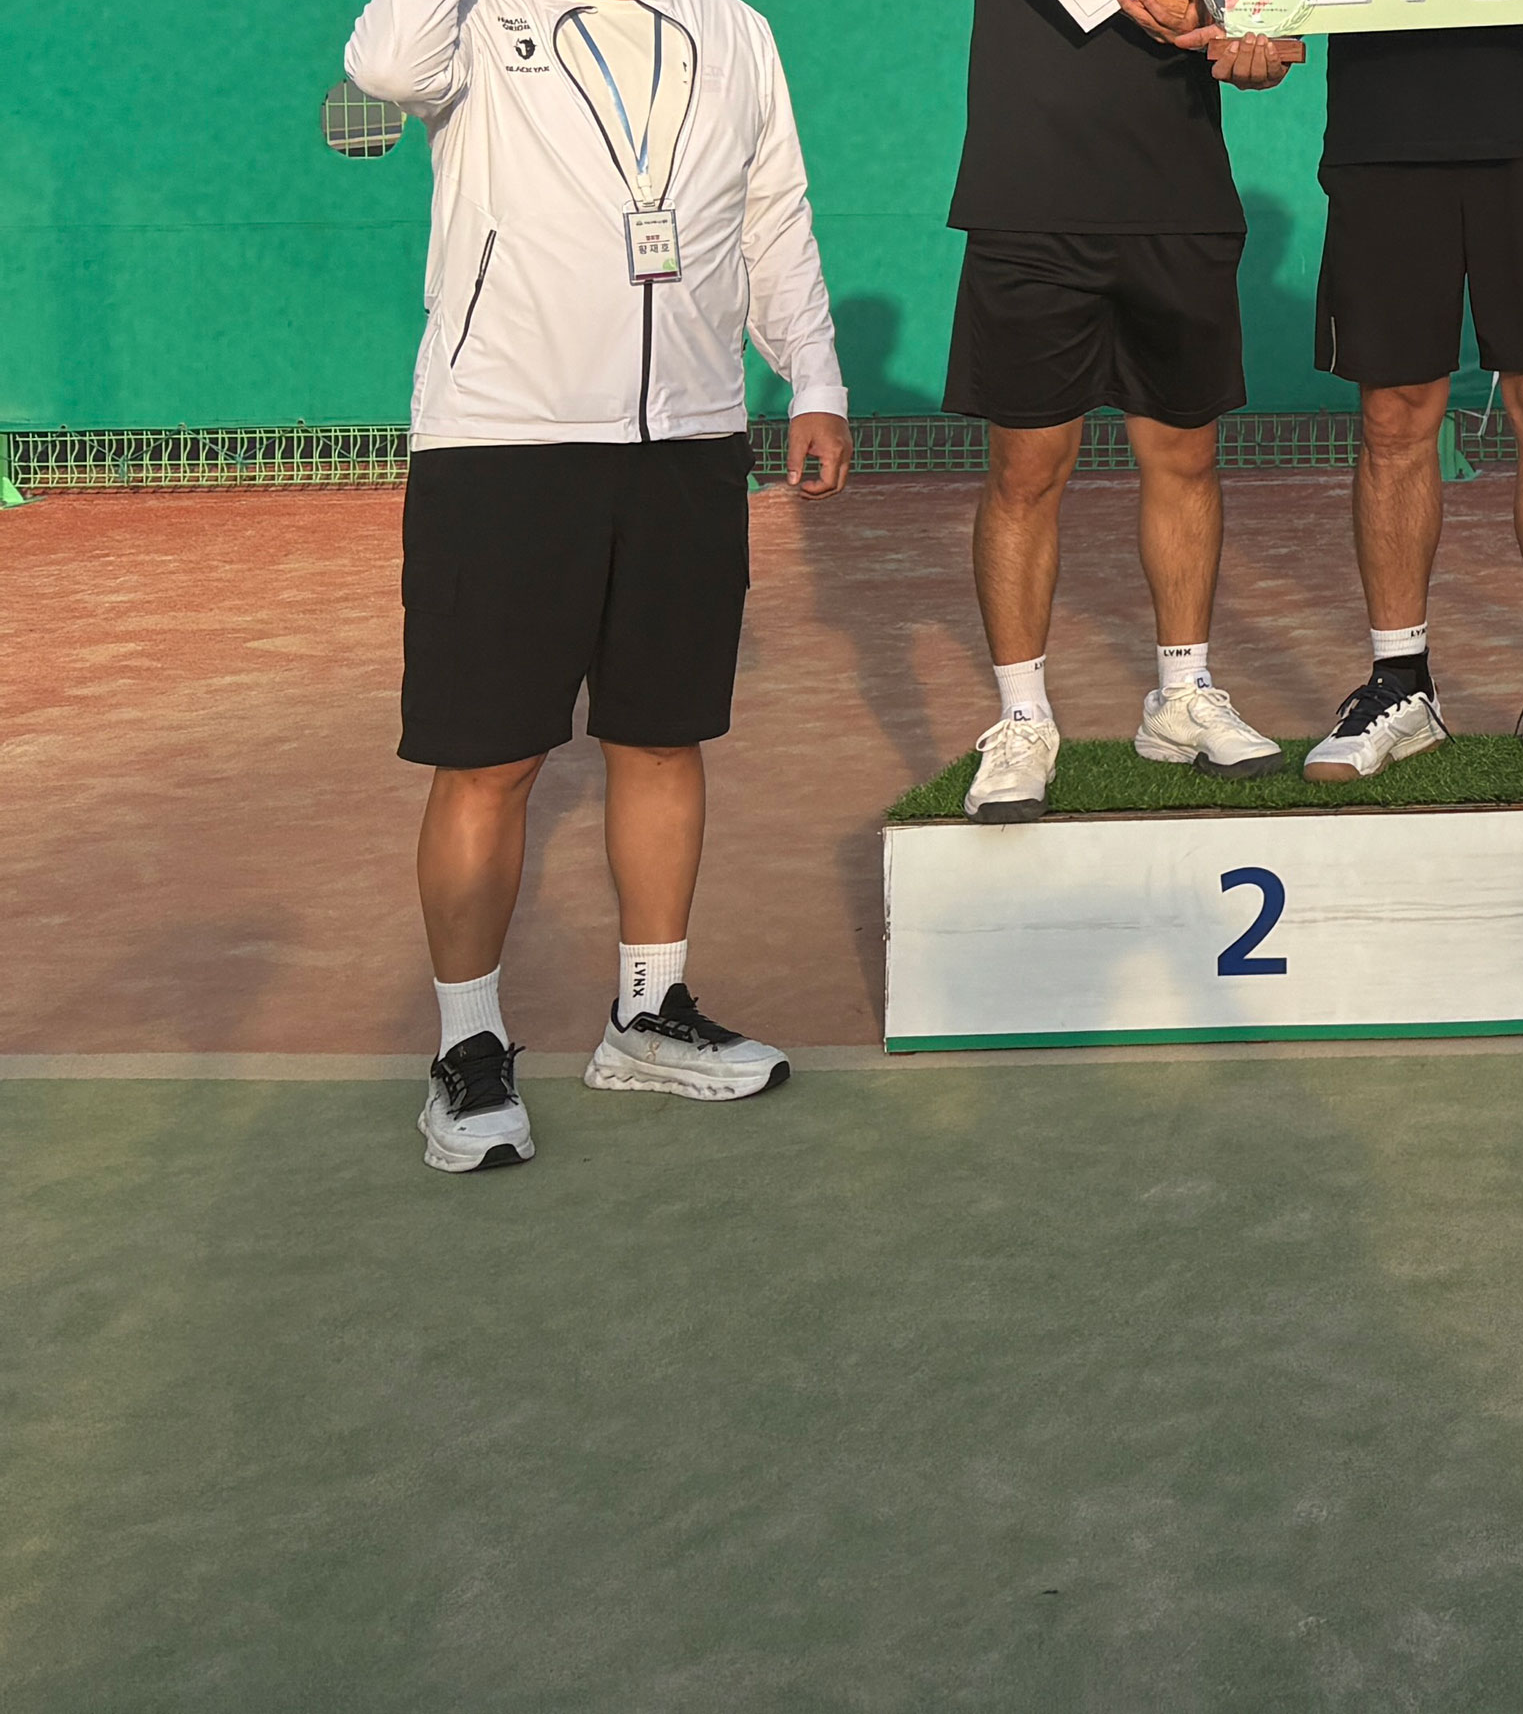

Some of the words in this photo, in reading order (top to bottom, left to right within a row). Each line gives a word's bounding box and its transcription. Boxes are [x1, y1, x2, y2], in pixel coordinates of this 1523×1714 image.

[1163, 648, 1191, 657] LYNX
[1217, 866, 1288, 976] 2
[632, 961, 647, 998] LYNX
